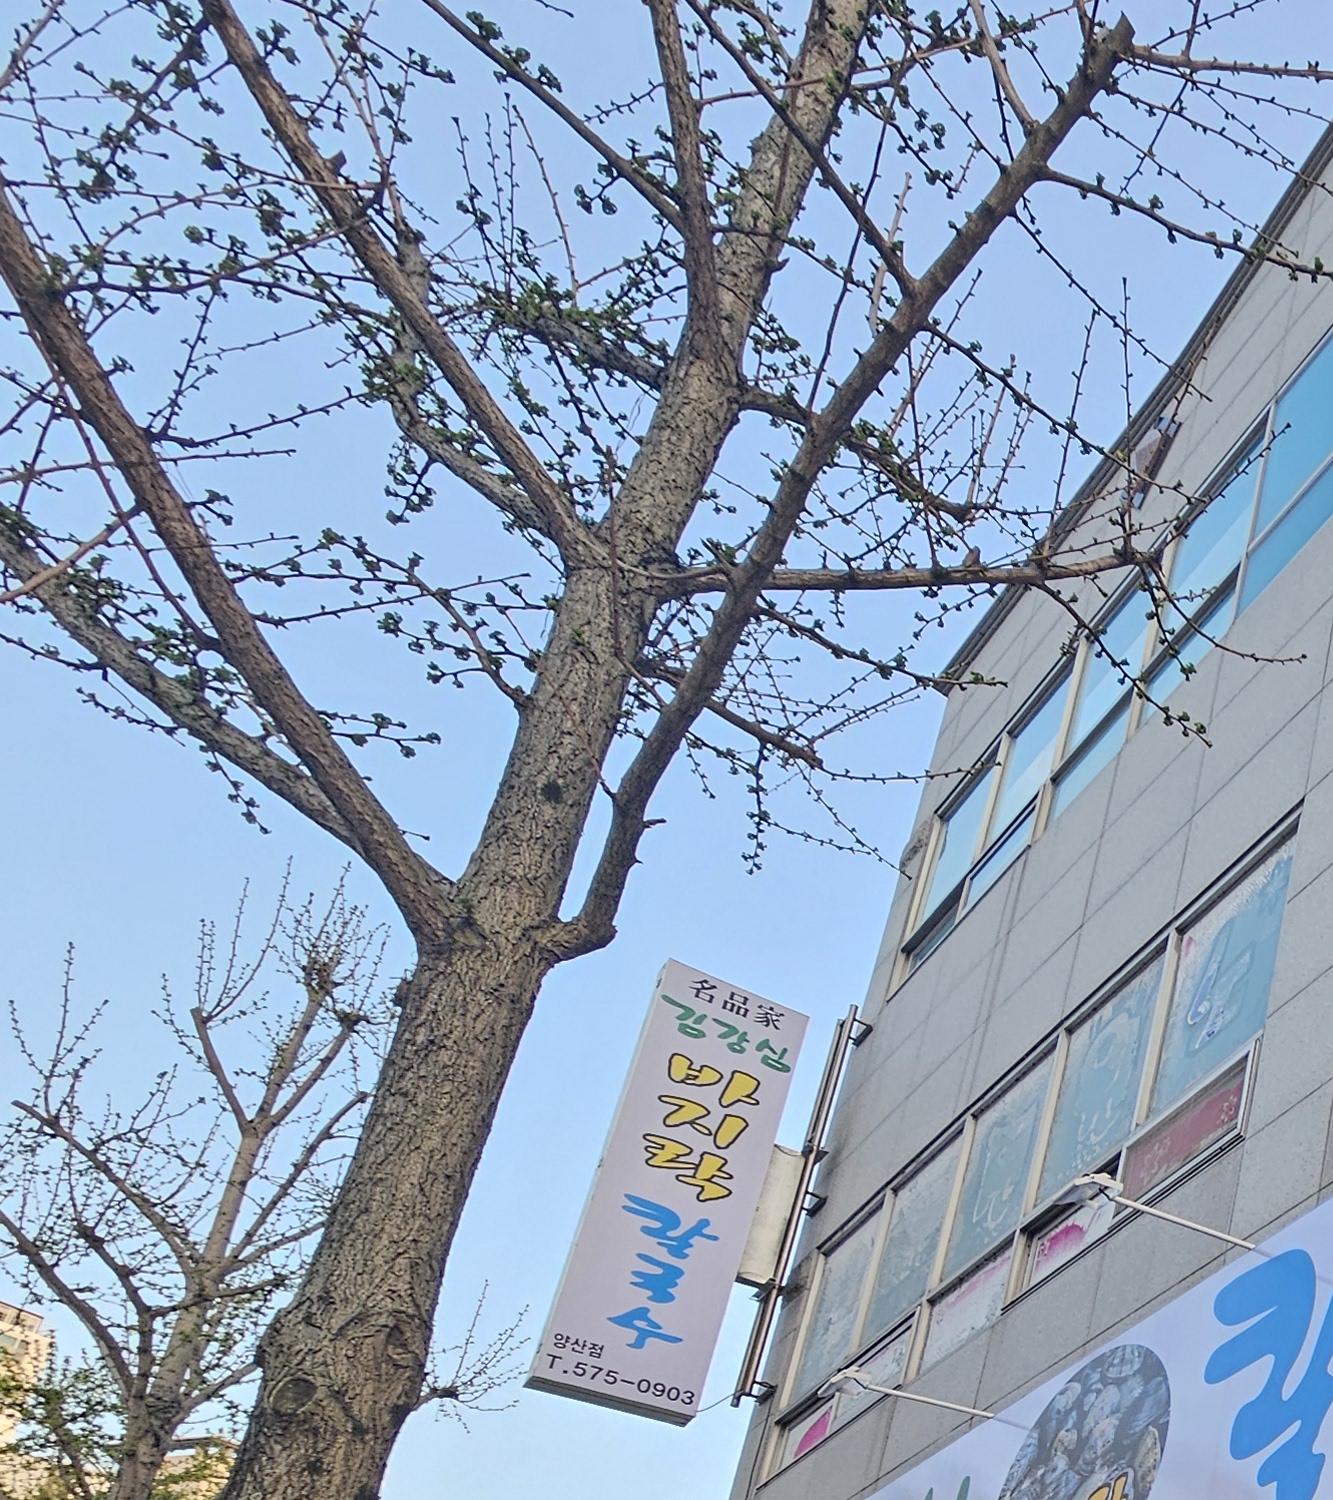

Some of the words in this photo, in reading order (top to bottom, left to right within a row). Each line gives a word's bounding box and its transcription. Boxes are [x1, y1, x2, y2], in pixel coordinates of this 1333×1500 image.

[661, 993, 792, 1074] 김강심
[687, 978, 786, 1032] 名品家
[644, 1052, 762, 1203] 바지락
[606, 1193, 721, 1350] 칼국수
[545, 1353, 696, 1408] T.575-0903
[553, 1333, 606, 1360] 양산점
